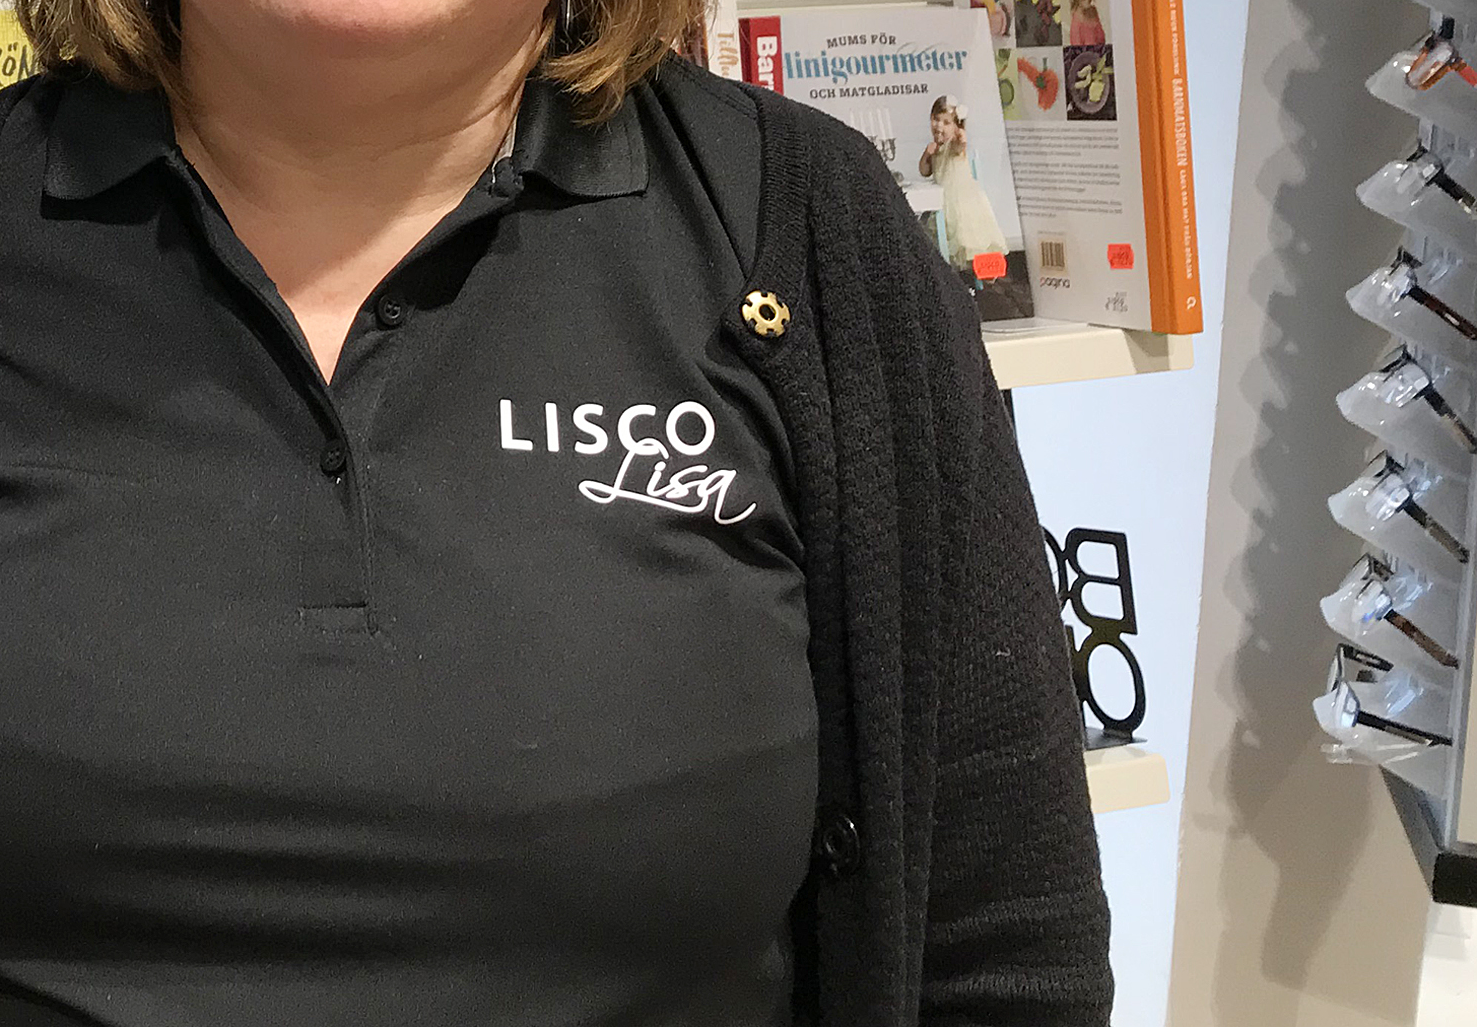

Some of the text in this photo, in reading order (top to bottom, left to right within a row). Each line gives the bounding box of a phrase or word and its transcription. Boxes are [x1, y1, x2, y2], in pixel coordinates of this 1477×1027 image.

[827, 33, 897, 49] MUMS FÖR
[810, 83, 929, 99] OCH MATGLADISAR
[499, 399, 716, 455] LISCO
[579, 438, 757, 525] Lisa
